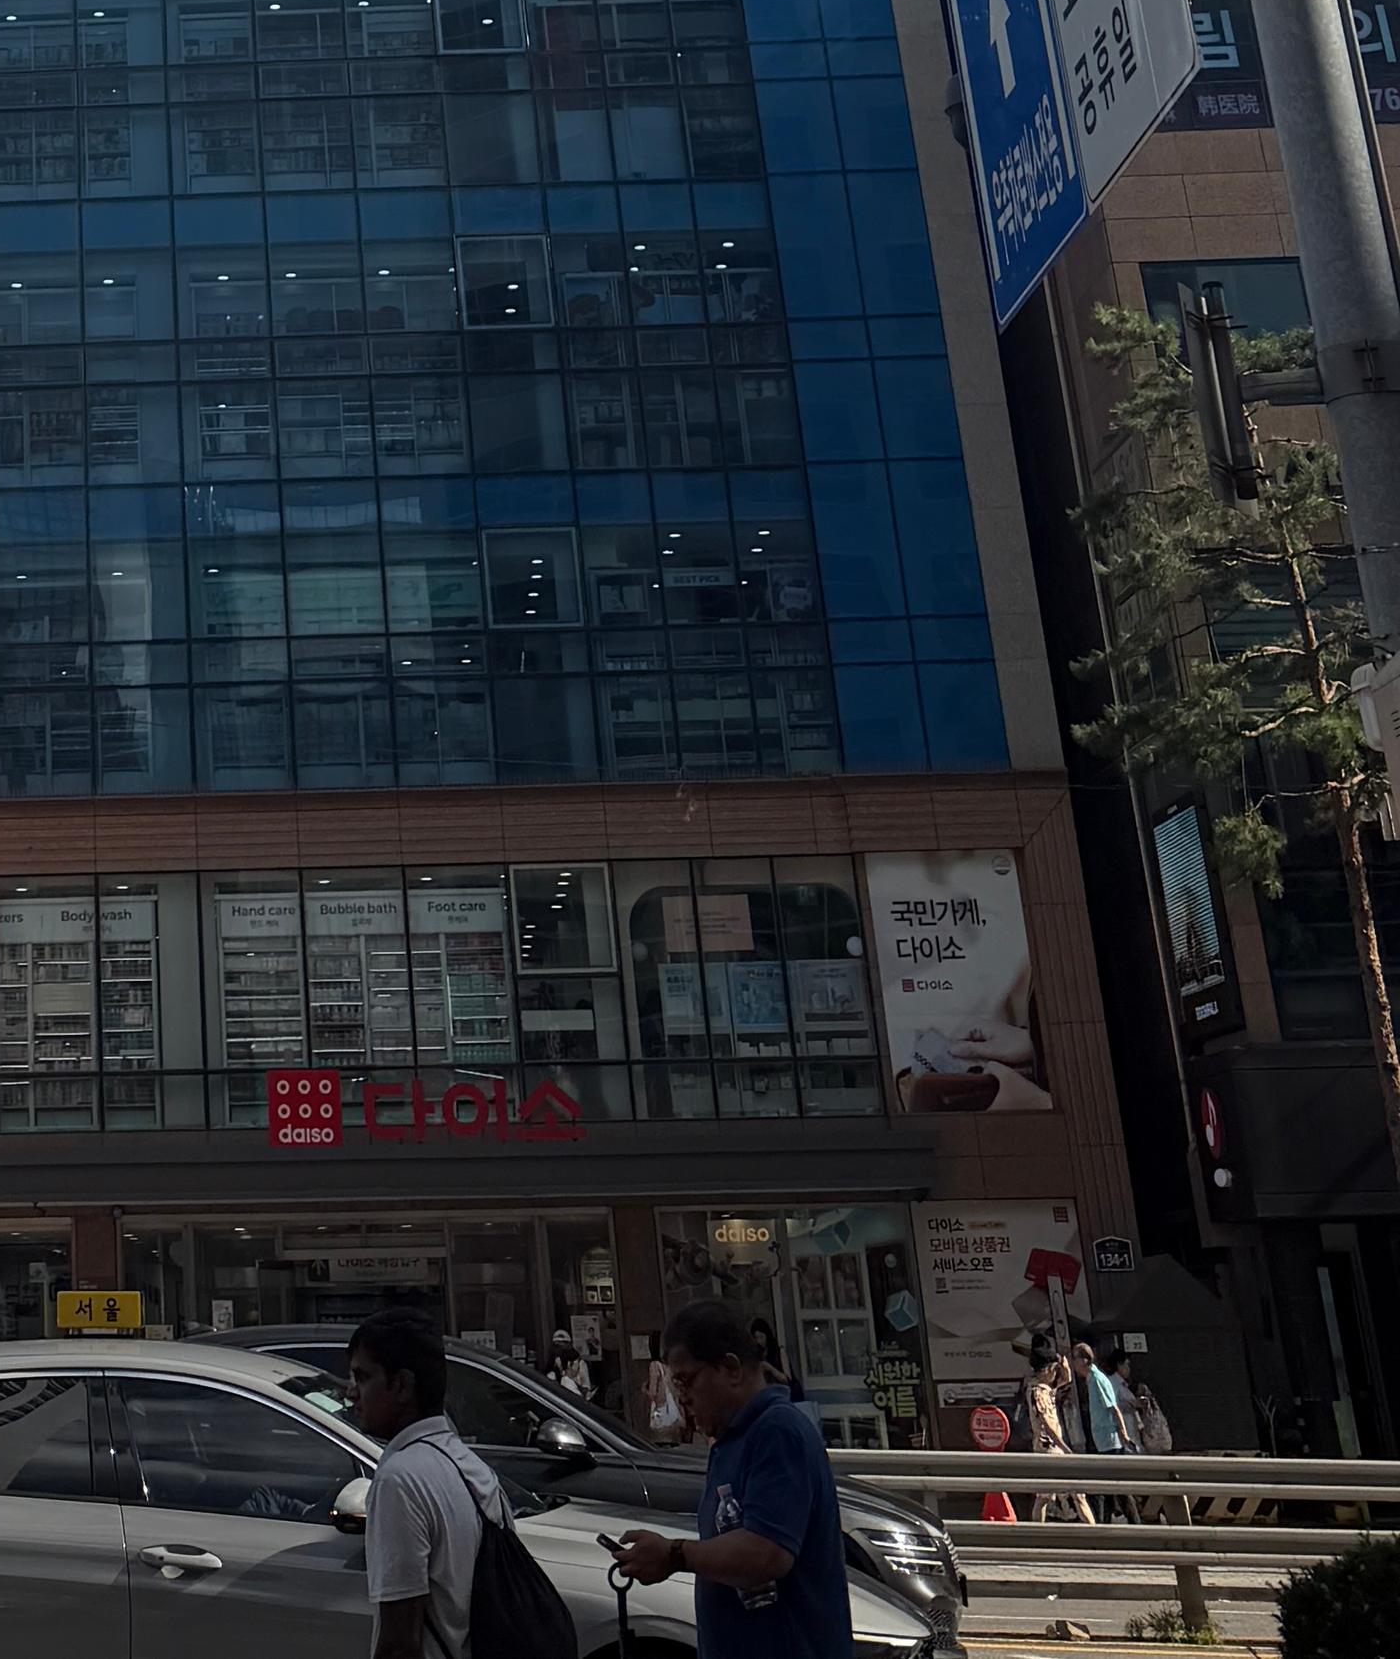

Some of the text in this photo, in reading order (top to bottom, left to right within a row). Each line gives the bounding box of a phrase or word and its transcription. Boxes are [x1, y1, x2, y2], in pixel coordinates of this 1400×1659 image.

[1196, 93, 1261, 118] 韩医院
[60, 909, 95, 924] Body
[231, 904, 297, 917] Hand care
[319, 901, 398, 915] Bubble bath
[427, 900, 487, 913] Foot care
[890, 897, 987, 928] 국민가게,
[895, 934, 967, 964] 다이소
[916, 979, 954, 991] 다이소
[362, 1078, 588, 1144] 다이소
[278, 1123, 335, 1144] daiso
[714, 1223, 770, 1243] daiso
[927, 1217, 965, 1233] 다이소
[929, 1235, 1012, 1254] 모바일 상품권
[932, 1256, 995, 1274] 서비스 오픈
[74, 1296, 122, 1323] 서울
[864, 1360, 921, 1388] 시원한
[872, 1385, 918, 1418] 여름
